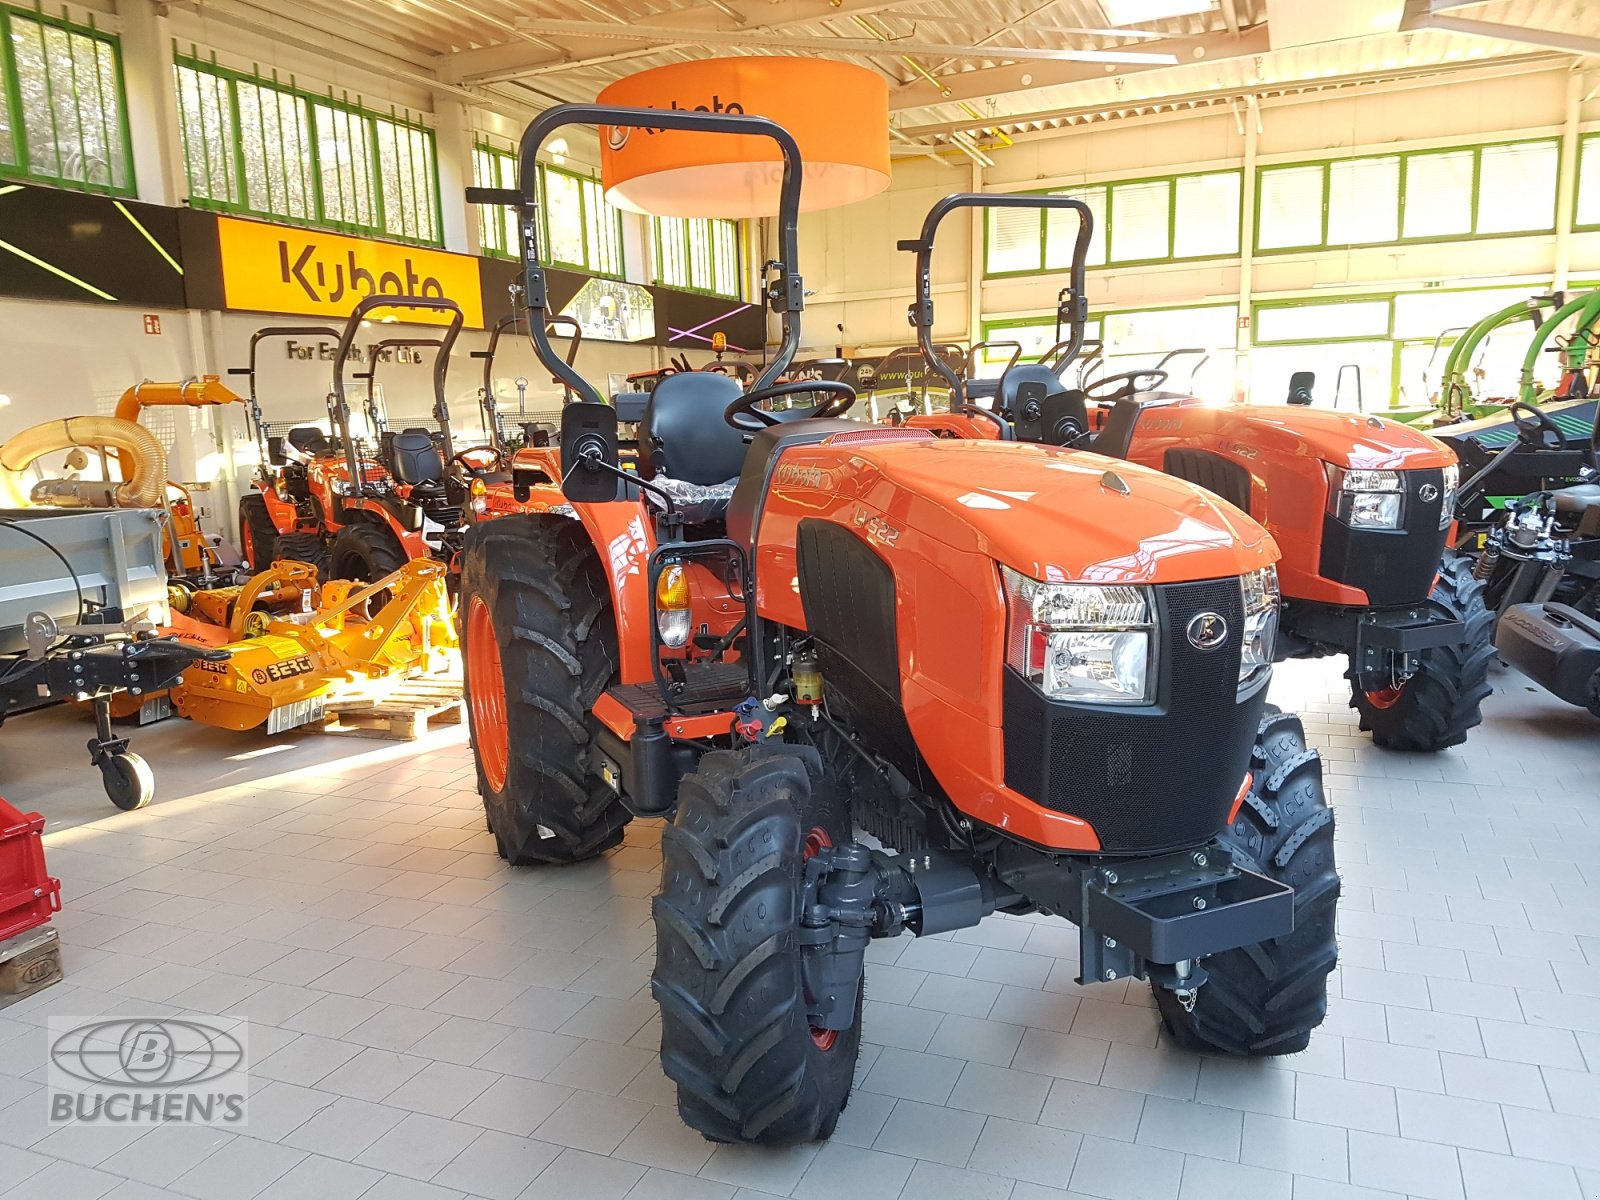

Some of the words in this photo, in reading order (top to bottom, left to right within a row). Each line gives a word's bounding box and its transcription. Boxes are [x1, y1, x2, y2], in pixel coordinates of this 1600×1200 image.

[278, 240, 446, 313] Kubota
[287, 341, 314, 360] For
[397, 345, 422, 364] Life
[777, 462, 822, 489] Kubota
[1503, 614, 1564, 648] JACOBSEN
[29, 961, 50, 981] EUR
